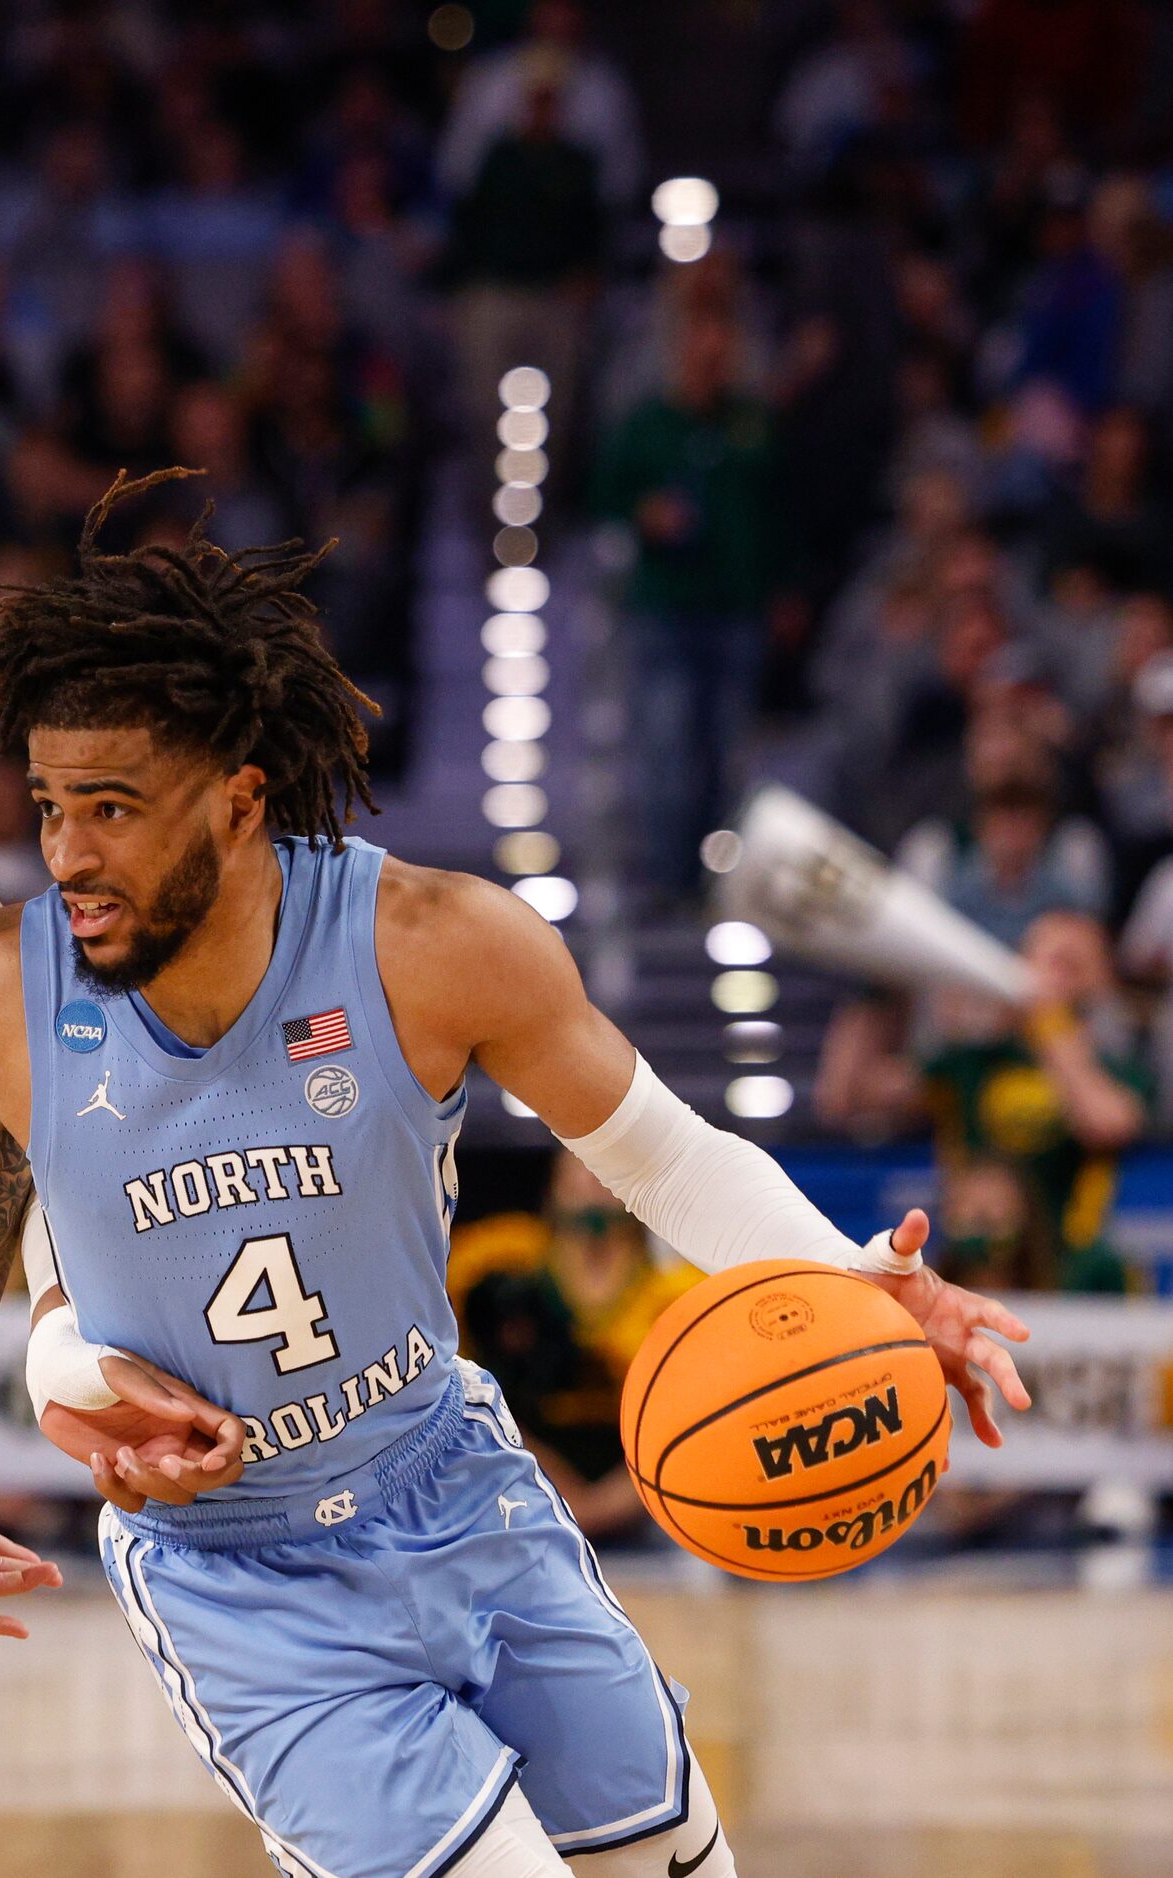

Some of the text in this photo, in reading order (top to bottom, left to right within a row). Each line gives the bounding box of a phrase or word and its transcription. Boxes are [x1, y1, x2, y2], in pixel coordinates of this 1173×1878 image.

[61, 1023, 103, 1041] NCAA
[312, 1078, 351, 1102] ACC
[124, 1145, 343, 1234] NORTH
[203, 1232, 340, 1376] 4
[237, 1324, 435, 1464] ROLINA
[749, 1414, 790, 1432] BALL
[752, 1384, 903, 1481] NCAA
[795, 1398, 837, 1418] GAME
[743, 1459, 936, 1552] Wilson
